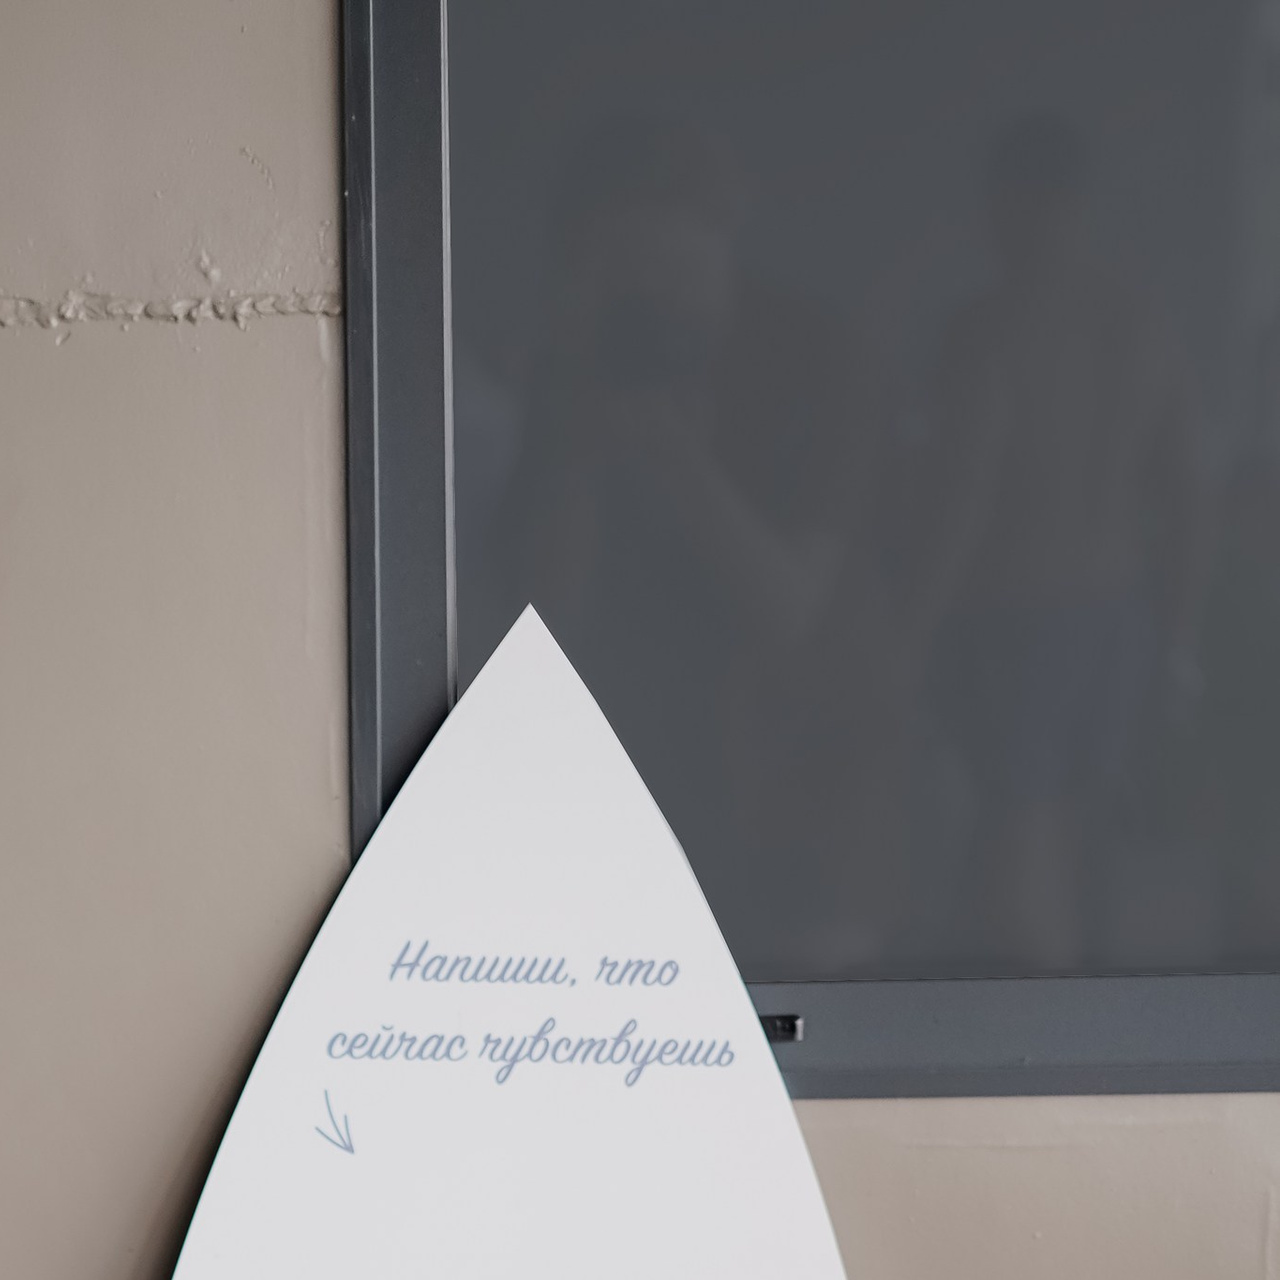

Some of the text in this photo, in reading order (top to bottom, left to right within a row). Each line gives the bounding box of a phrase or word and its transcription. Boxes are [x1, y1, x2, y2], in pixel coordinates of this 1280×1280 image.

[389, 939, 680, 987] Напиши, что
[326, 1016, 736, 1087] сейчас чувствуешь
